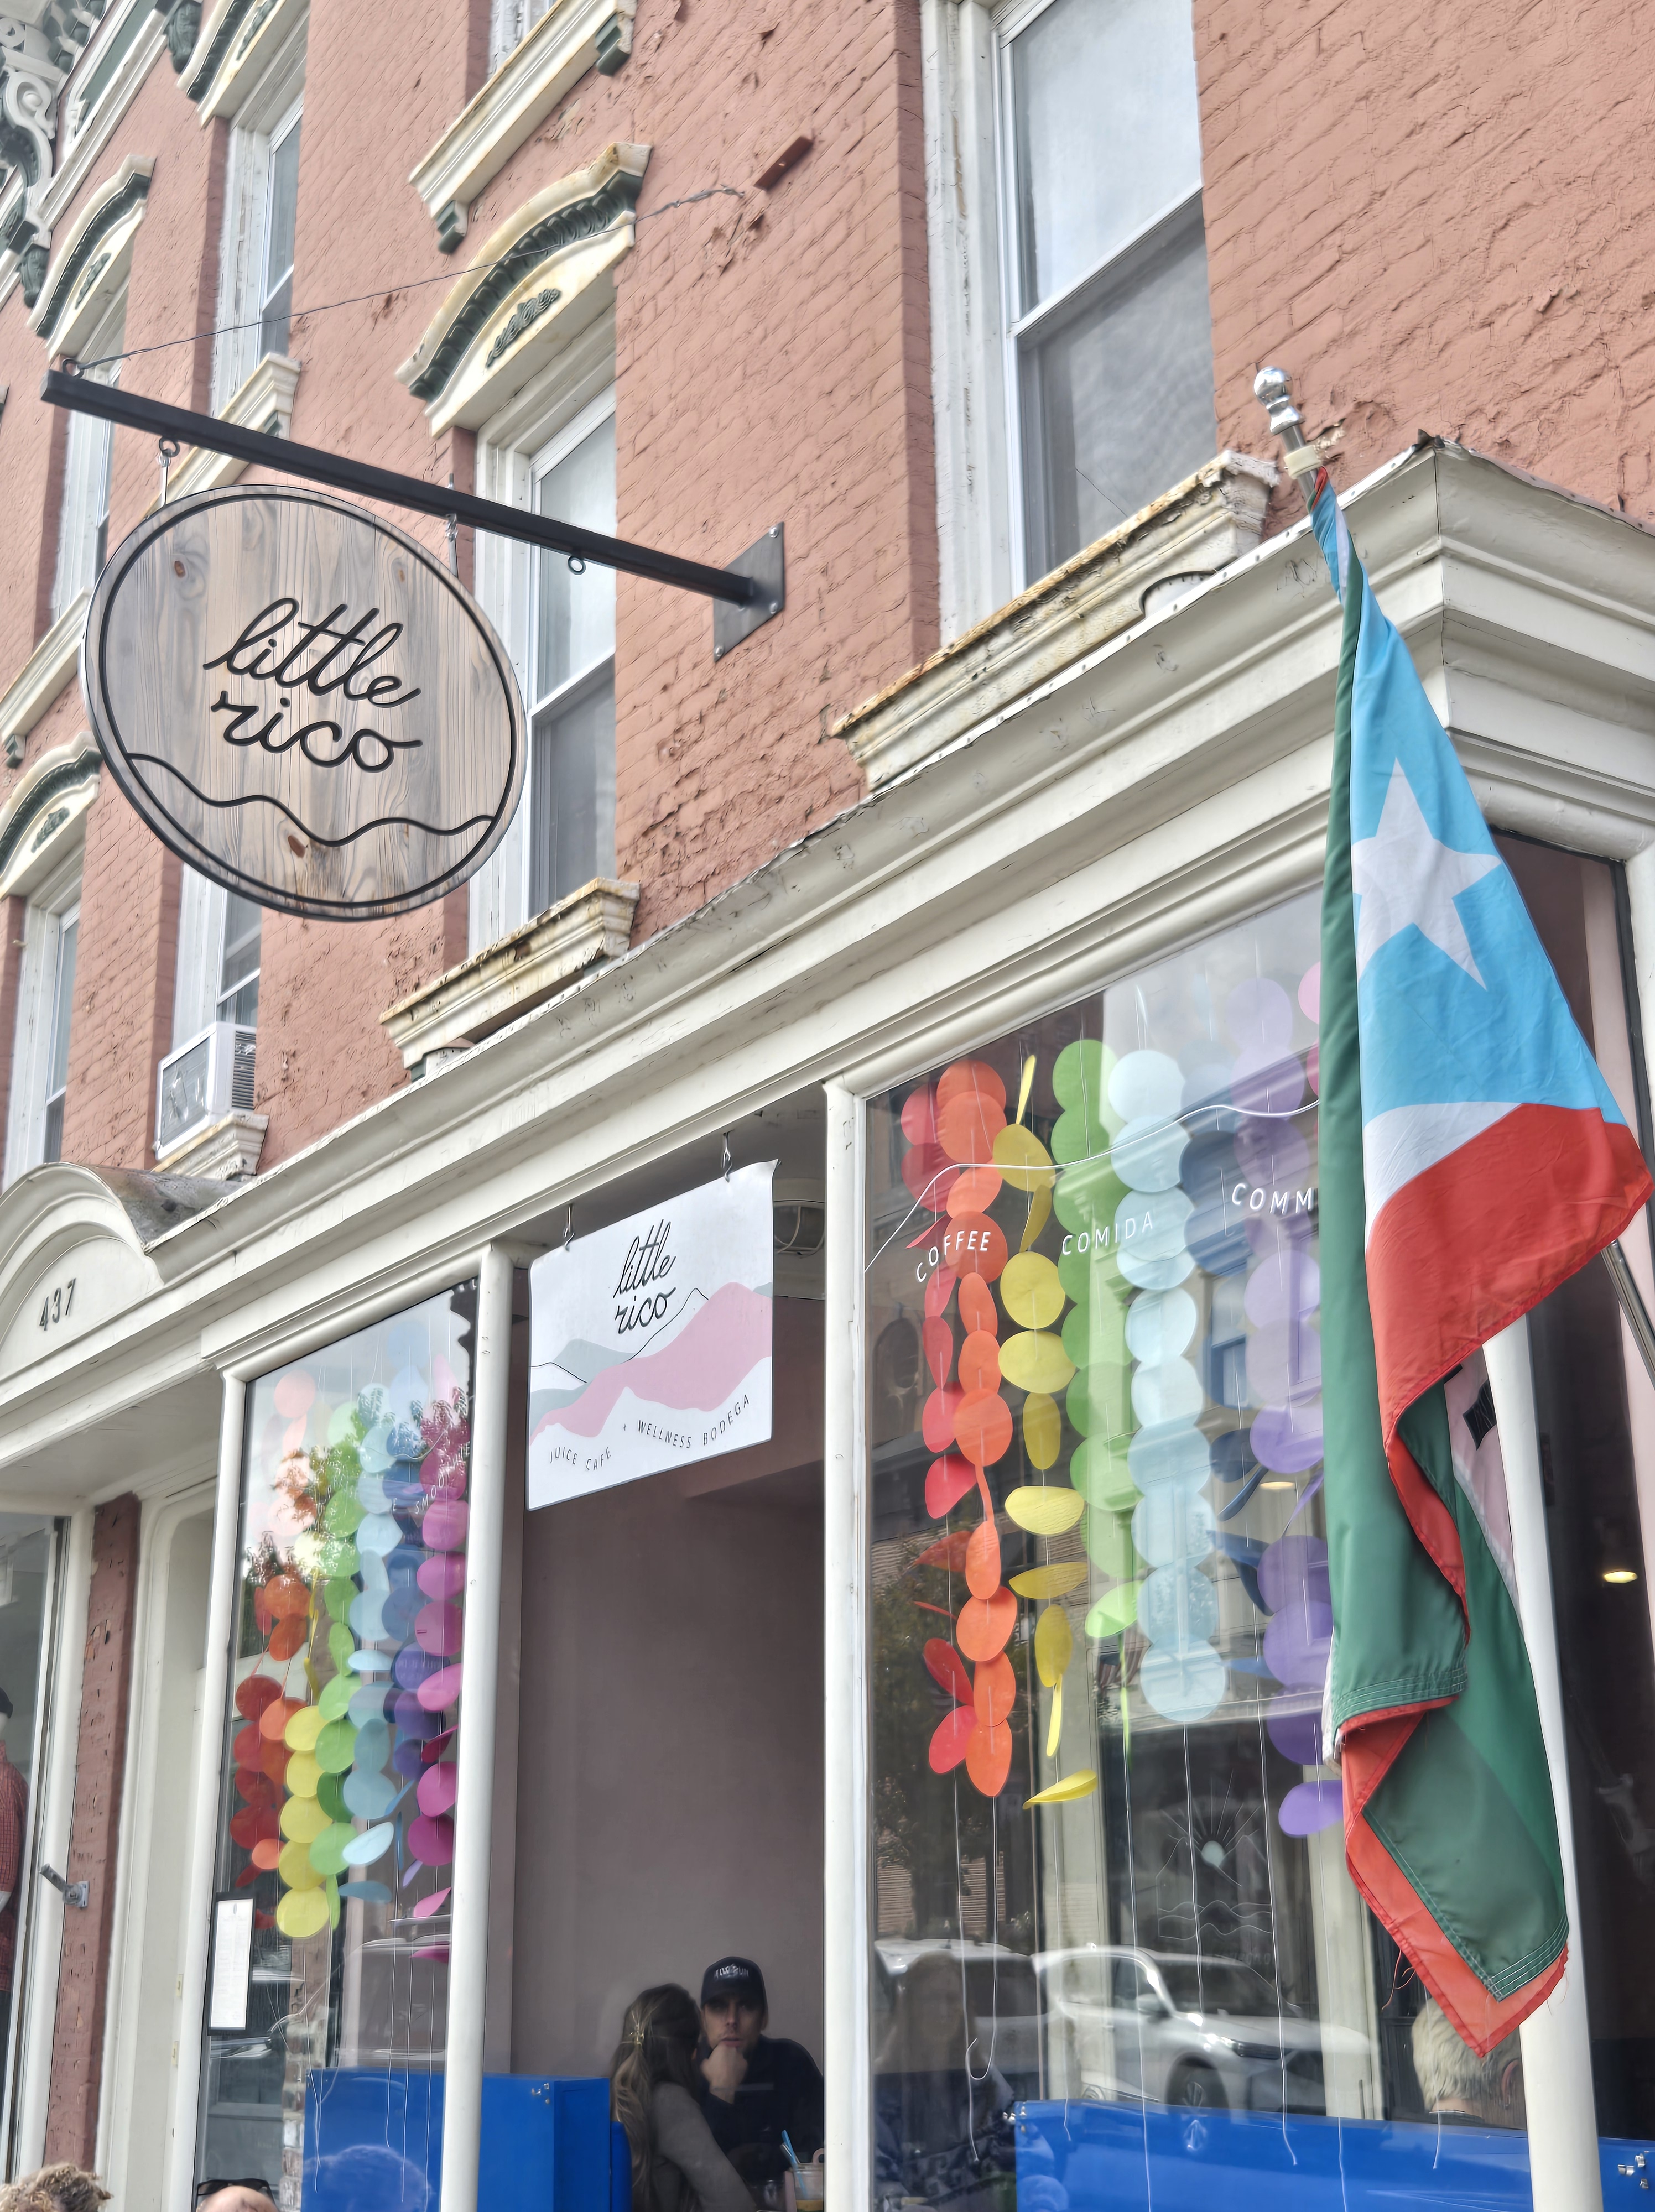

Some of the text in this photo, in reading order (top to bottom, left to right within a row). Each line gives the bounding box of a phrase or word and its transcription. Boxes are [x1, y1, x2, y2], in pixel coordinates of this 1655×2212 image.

[202, 597, 421, 708] little
[211, 690, 423, 772] rico
[613, 1218, 676, 1298] little
[915, 1183, 1314, 1283] COFFEE COMIDA COMM
[39, 1277, 76, 1331] 437
[615, 1287, 676, 1334] rico
[550, 1447, 578, 1465] JUICE
[585, 1446, 611, 1471] CAFE
[638, 1420, 692, 1449] WELLNESS
[703, 1394, 750, 1446] BODEGA
